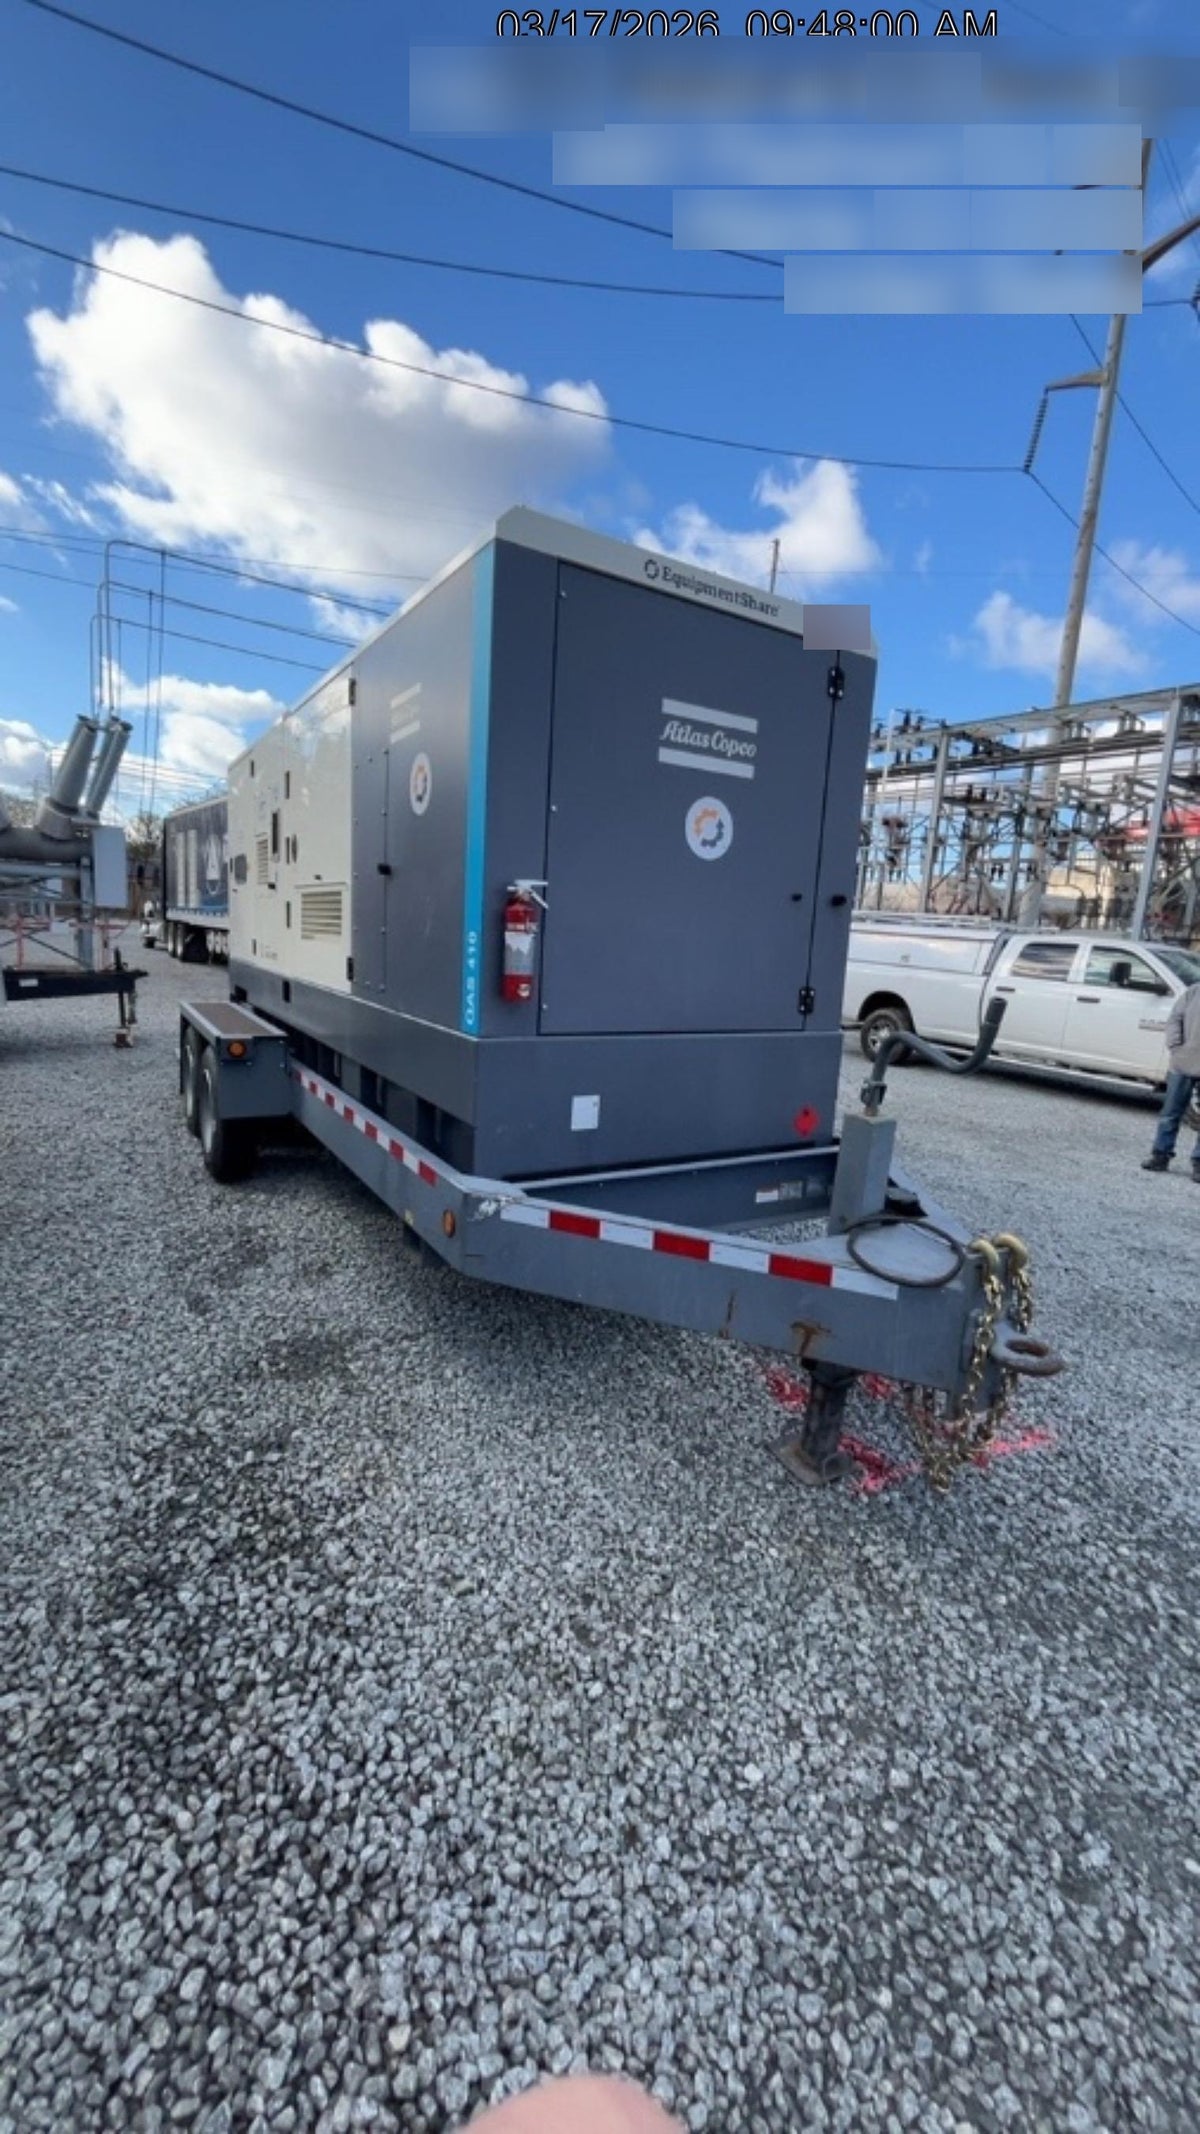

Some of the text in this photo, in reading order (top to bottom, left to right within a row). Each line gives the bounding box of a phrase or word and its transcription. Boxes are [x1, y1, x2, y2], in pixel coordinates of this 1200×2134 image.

[663, 566, 779, 617] EquipmentShare
[660, 720, 758, 757] Atlas Copco
